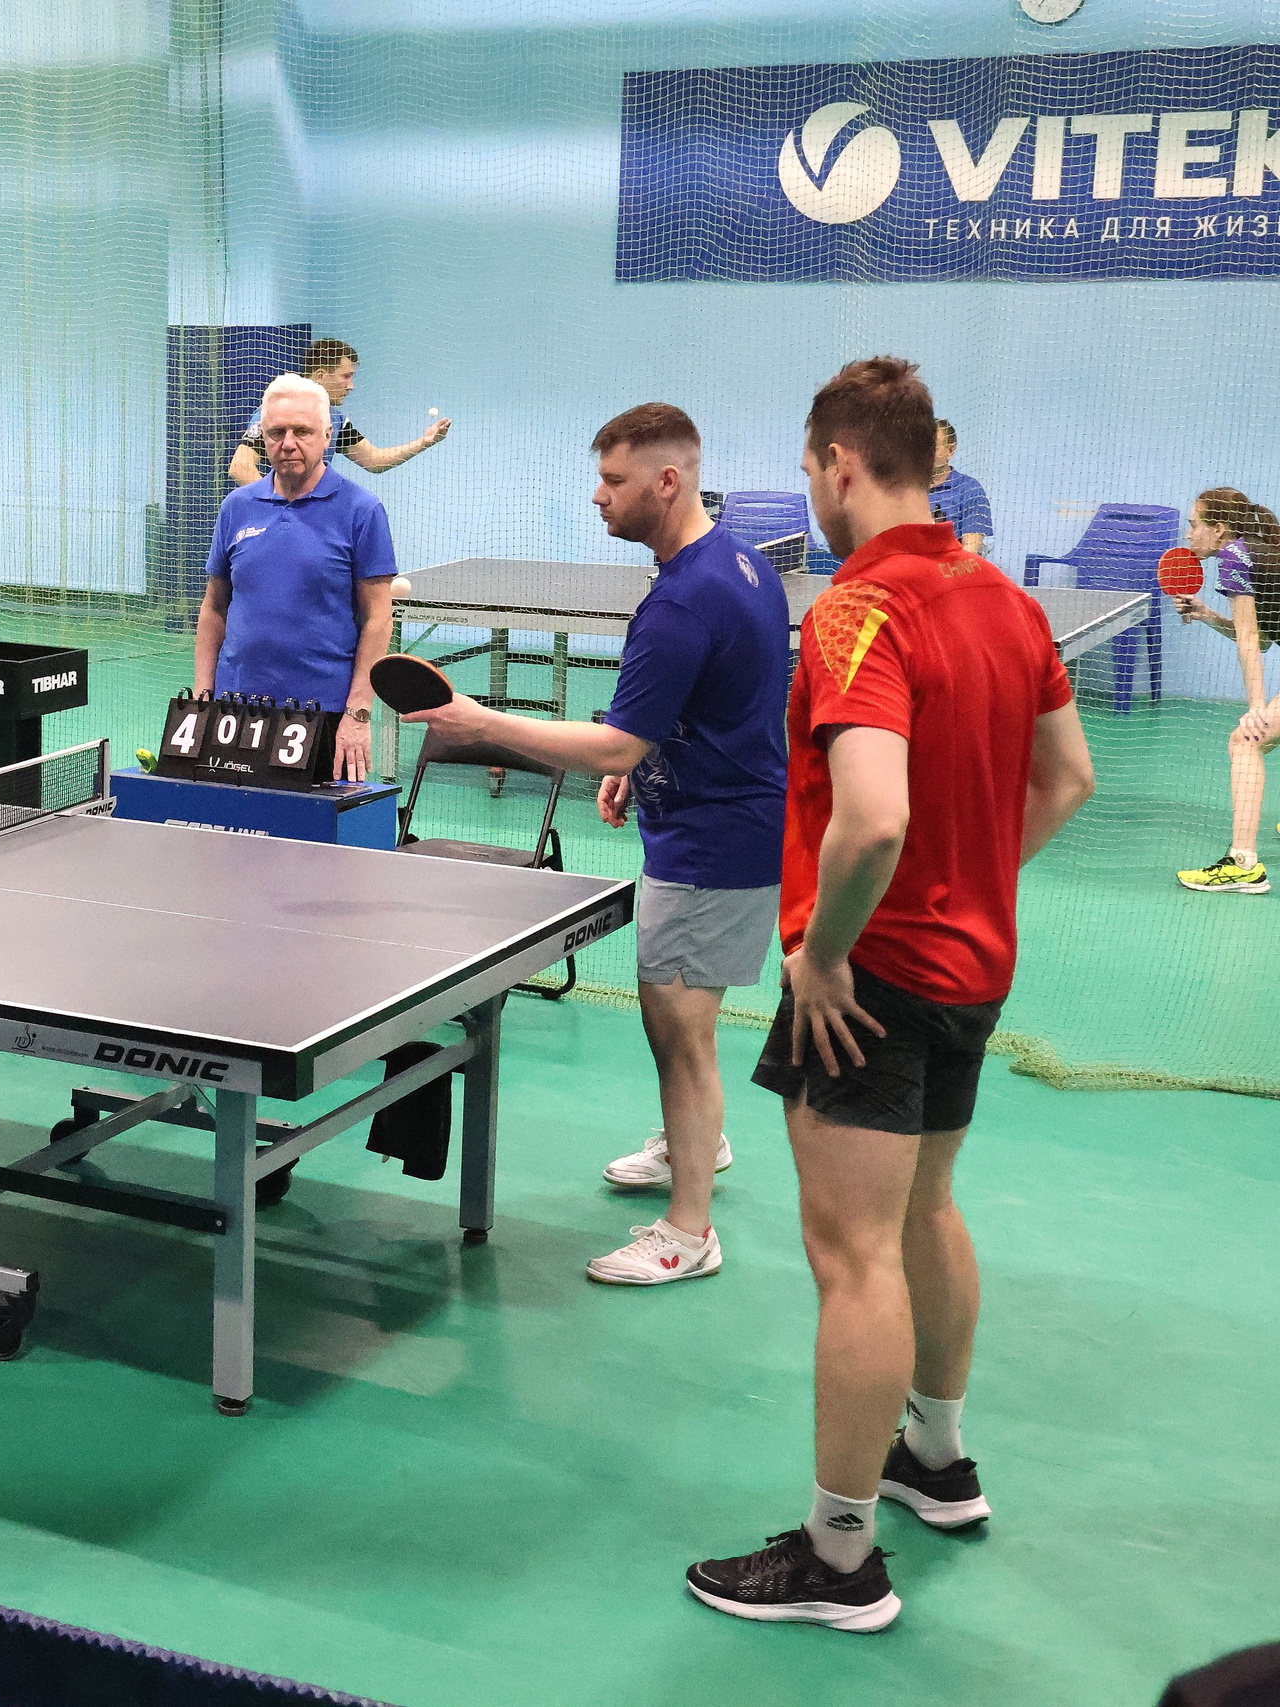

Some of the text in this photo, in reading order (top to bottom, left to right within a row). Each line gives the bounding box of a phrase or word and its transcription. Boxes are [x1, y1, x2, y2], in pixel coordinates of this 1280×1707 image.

[924, 214, 1280, 243] ТЕХНИКА ДЛЯ ЖИЗ
[31, 670, 77, 694] TIBHAR
[170, 713, 307, 765] 4 0 1 3
[563, 911, 613, 953] DONIC
[93, 1042, 230, 1082] DONIC
